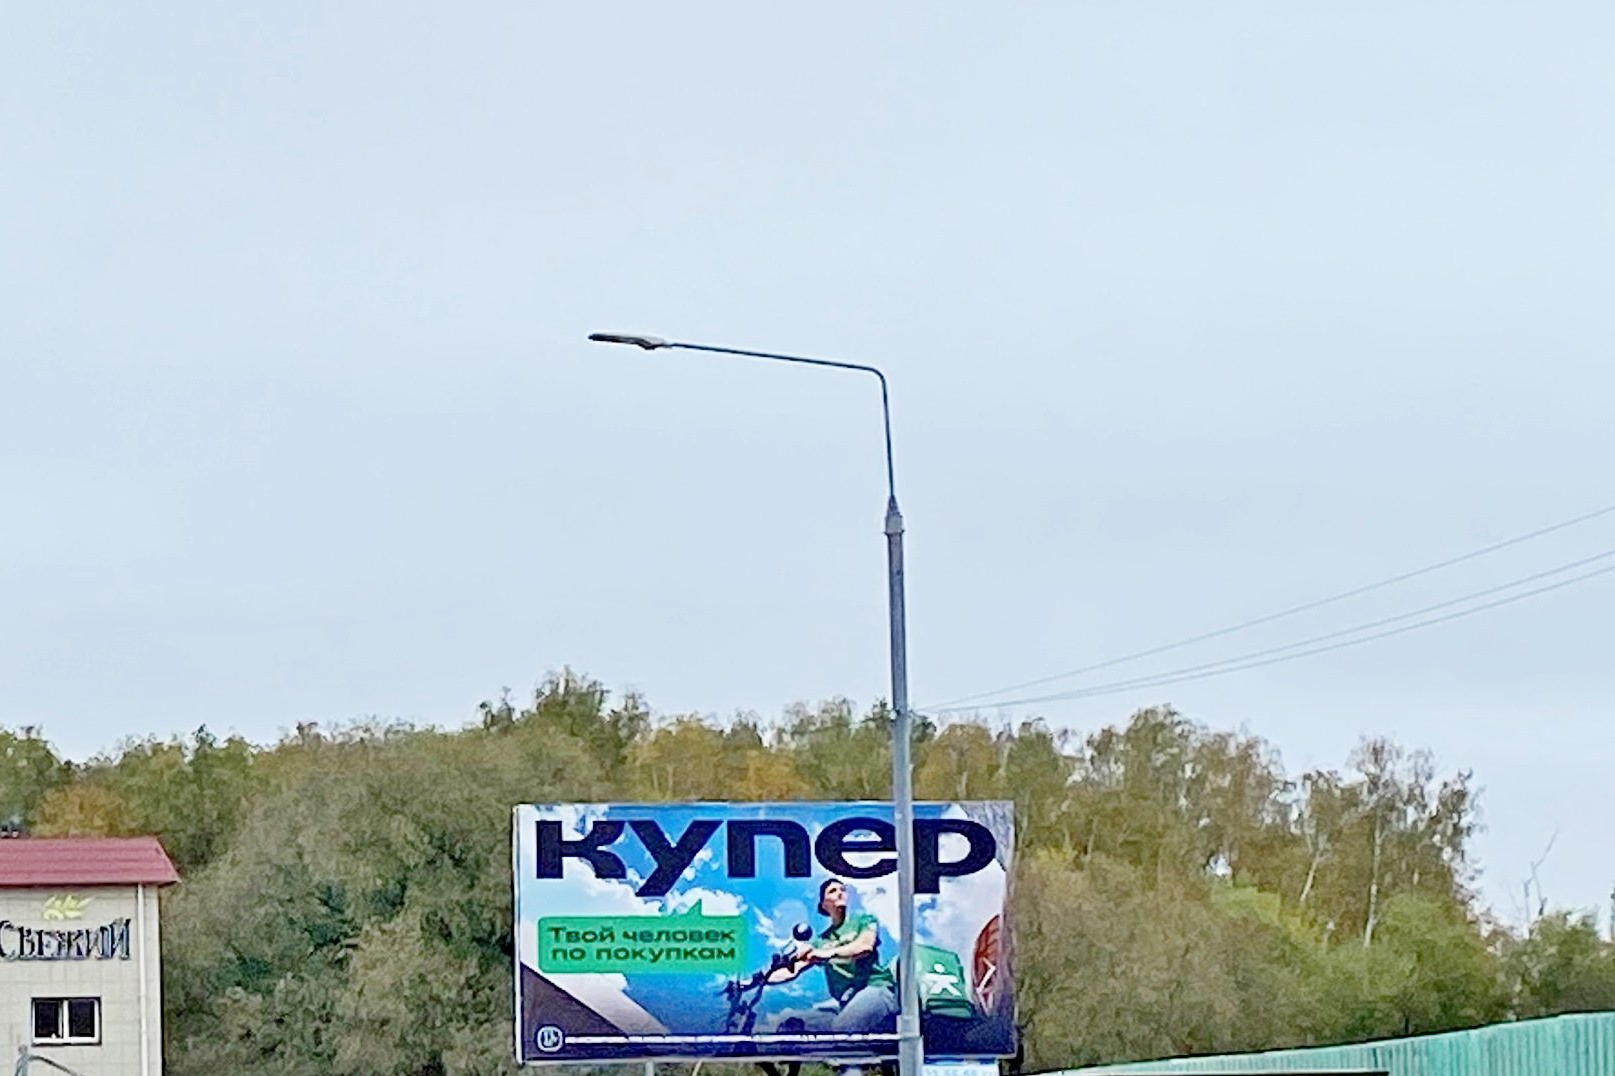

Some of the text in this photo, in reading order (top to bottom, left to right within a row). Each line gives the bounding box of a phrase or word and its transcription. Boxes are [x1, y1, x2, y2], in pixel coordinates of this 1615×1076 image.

[535, 816, 997, 897] купер
[548, 925, 737, 944] Твой человек
[551, 947, 736, 964] по покупкам
